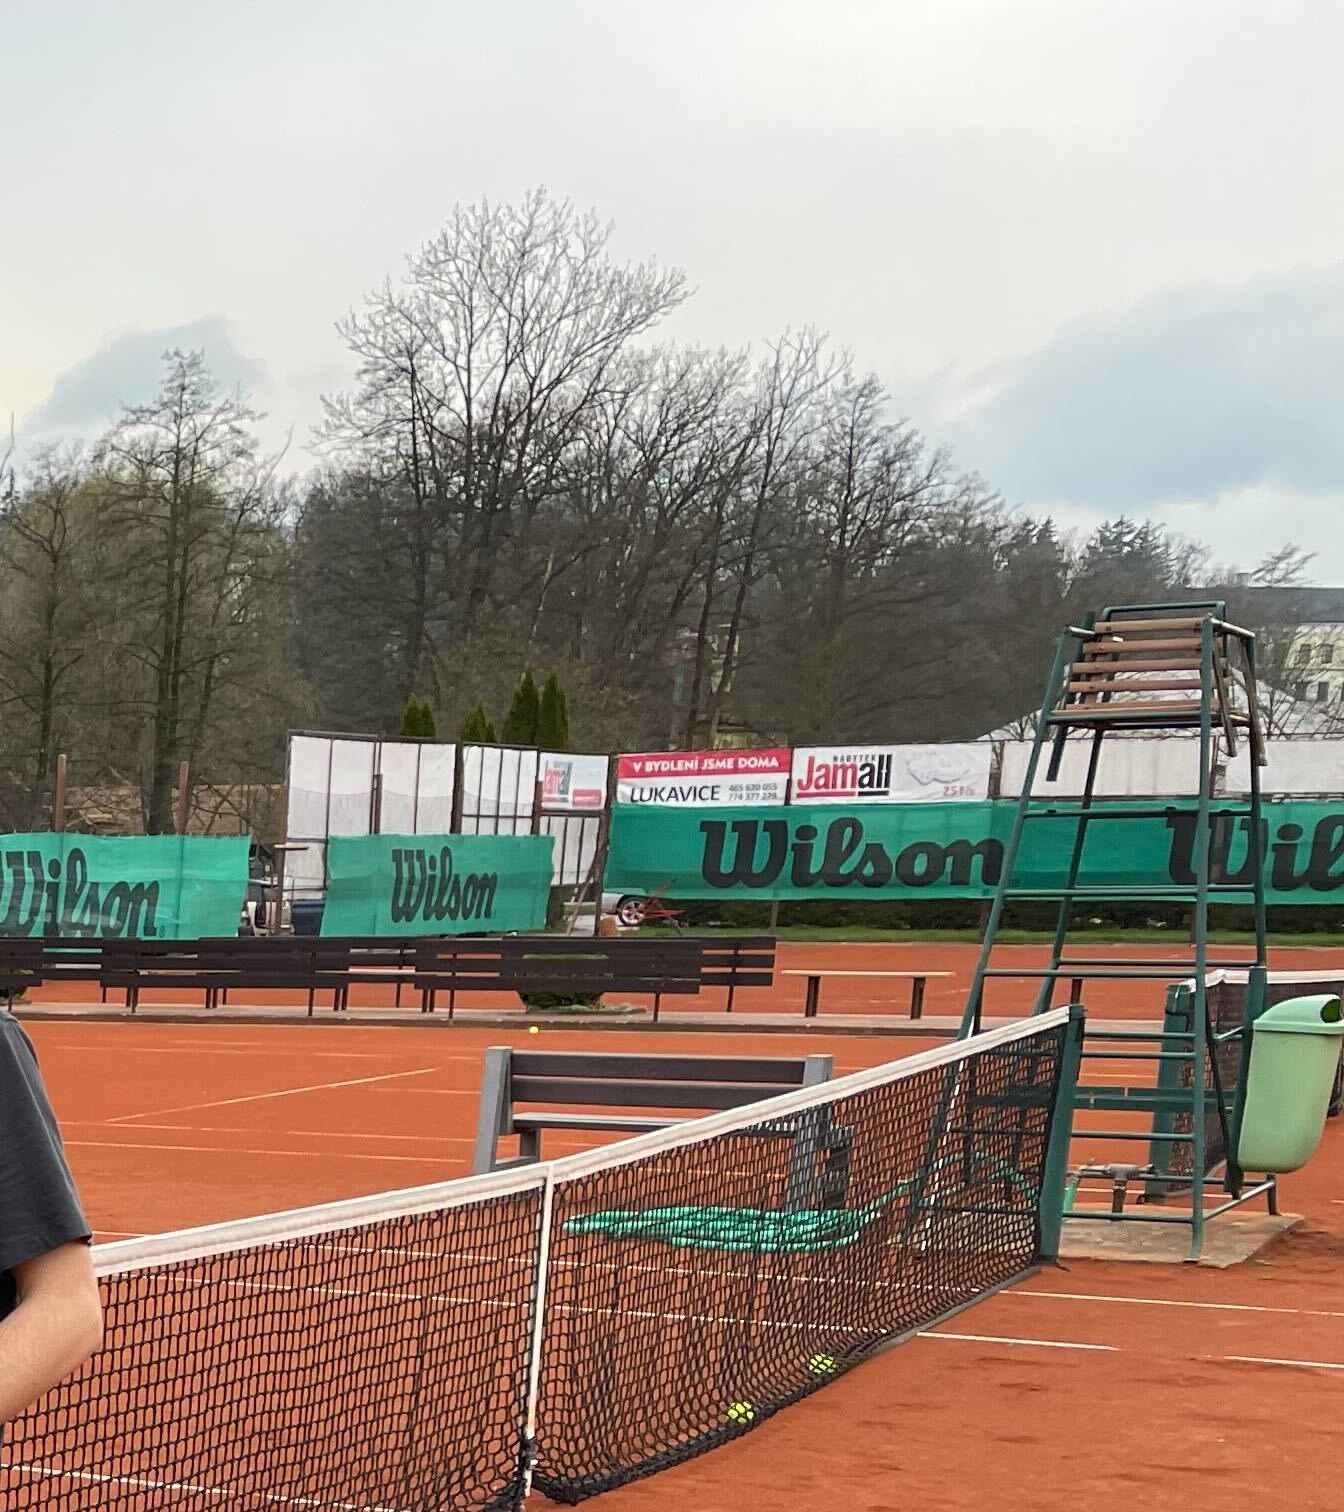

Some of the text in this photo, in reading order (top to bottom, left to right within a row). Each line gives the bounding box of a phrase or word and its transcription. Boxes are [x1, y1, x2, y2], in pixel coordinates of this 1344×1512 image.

[633, 762, 642, 773] V
[701, 758, 735, 770] JSME
[738, 756, 780, 769] DOMA
[797, 754, 892, 791] Jamall
[630, 784, 721, 804] LUKAVICE
[700, 817, 1005, 888] Wilson
[391, 846, 497, 923] Wilson
